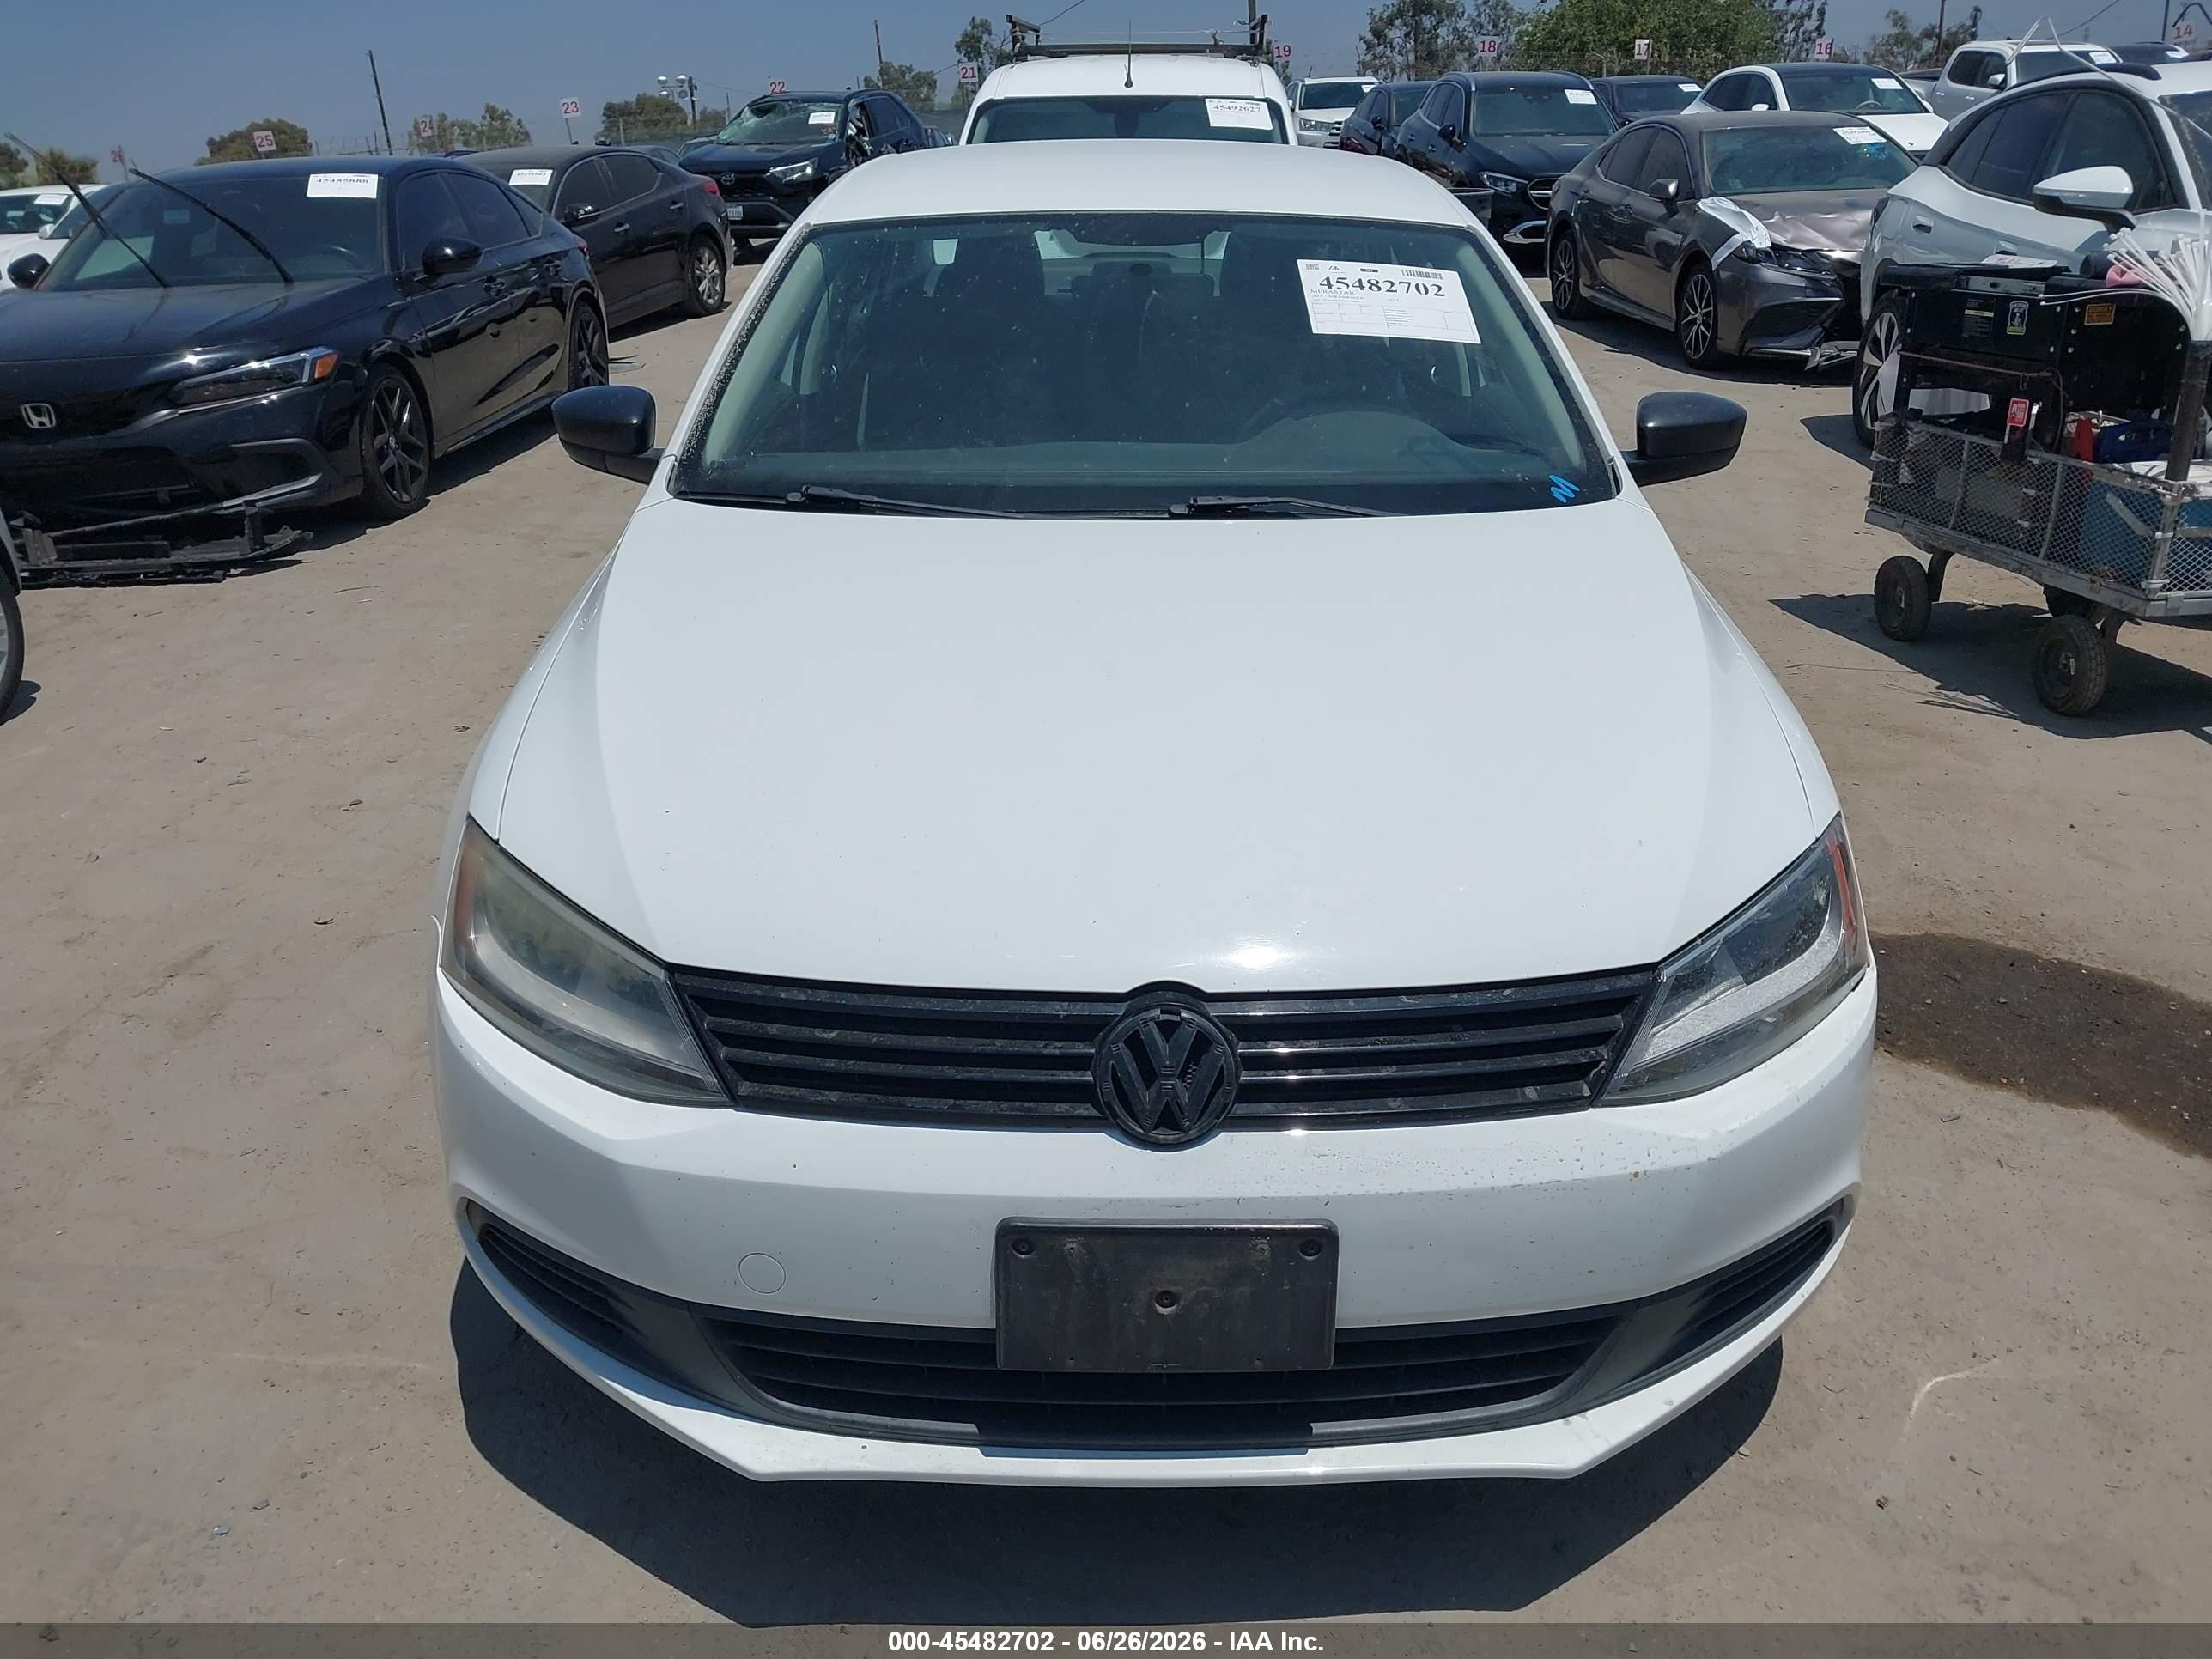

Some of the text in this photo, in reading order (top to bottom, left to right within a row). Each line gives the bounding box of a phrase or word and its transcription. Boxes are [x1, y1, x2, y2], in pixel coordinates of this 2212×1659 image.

[2173, 24, 2193, 40] 14
[1274, 45, 1291, 58] 19
[1480, 40, 1497, 53] 18
[1636, 43, 1649, 56] 17
[1816, 42, 1832, 55] 16
[960, 66, 976, 80] 21
[769, 82, 786, 94] 22
[562, 101, 580, 114] 23
[257, 134, 274, 148] 25
[1319, 276, 1445, 297] 45482702
